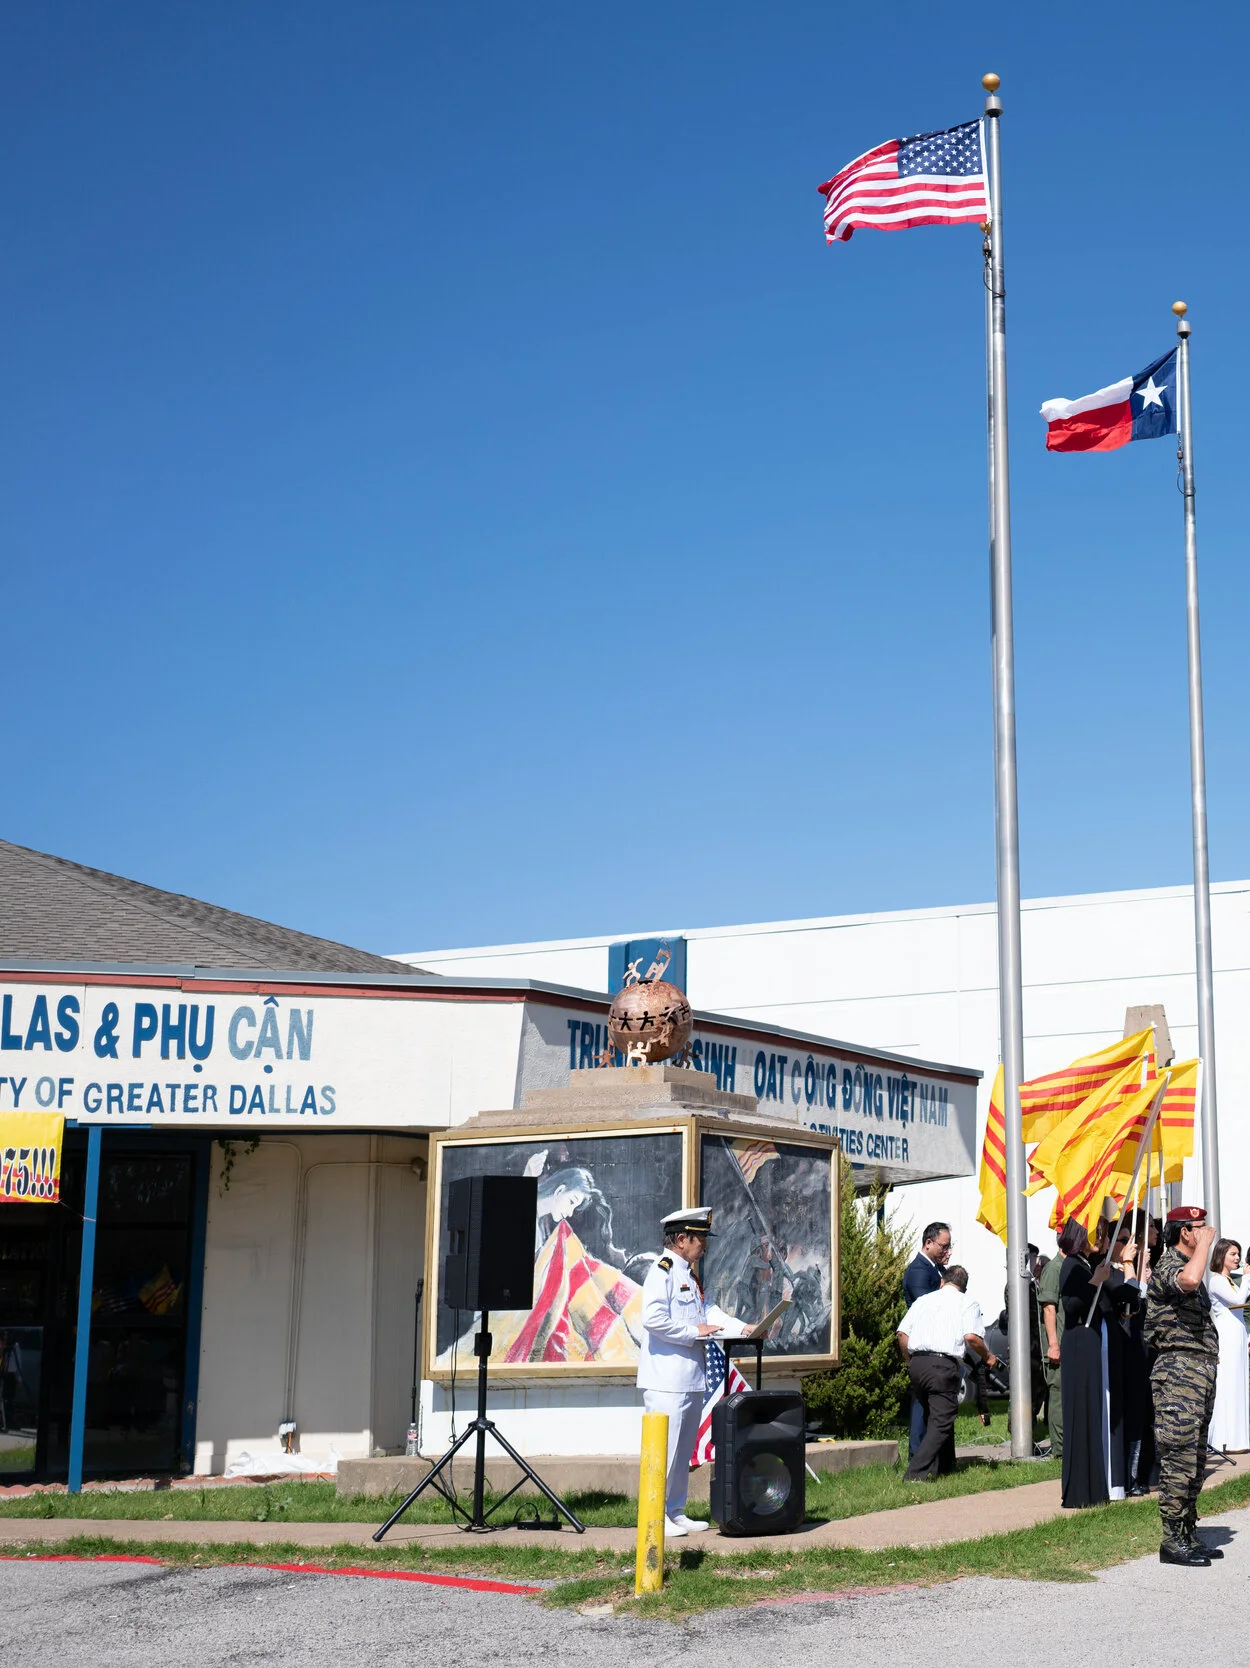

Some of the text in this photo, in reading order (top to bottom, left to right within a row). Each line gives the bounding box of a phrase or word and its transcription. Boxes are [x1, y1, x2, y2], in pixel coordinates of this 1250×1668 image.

[1, 995, 314, 1074] LAS & PHỤ CẬN
[35, 1076, 75, 1109] OF
[83, 1082, 218, 1115] GREATER
[229, 1084, 337, 1116] DALLAS
[887, 1073, 917, 1129] VIỆT
[920, 1083, 948, 1127] NAM
[0, 1147, 55, 1197] 75!!!
[866, 1133, 909, 1163] CENTER
